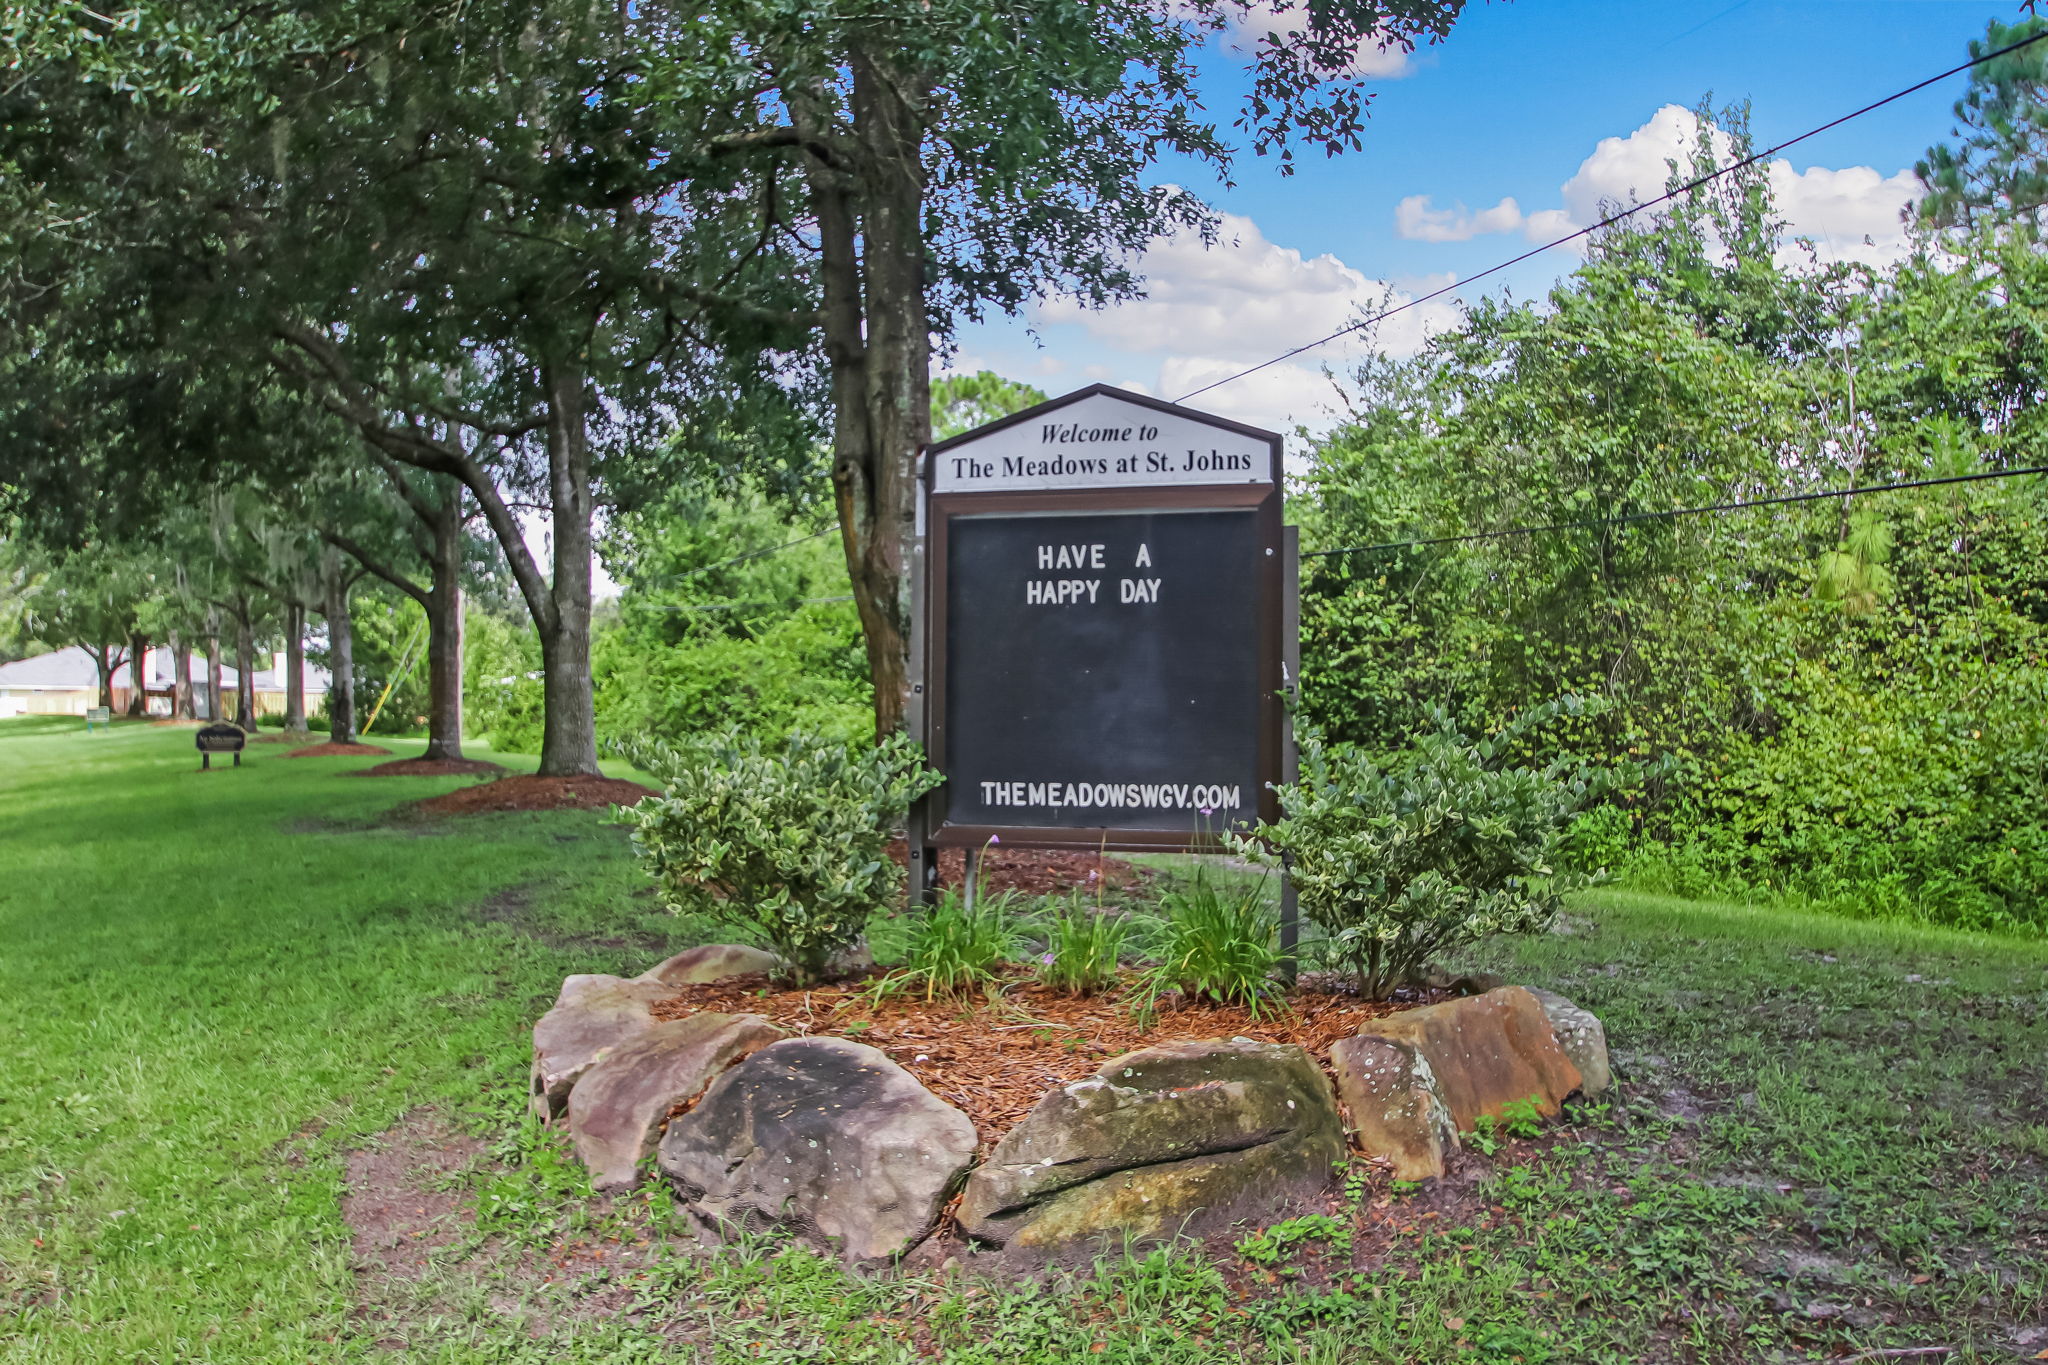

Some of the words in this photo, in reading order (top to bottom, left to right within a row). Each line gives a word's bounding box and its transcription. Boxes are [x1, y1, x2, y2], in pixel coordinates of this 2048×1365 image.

[1041, 424, 1131, 444] Welcome
[1138, 424, 1158, 441] to
[952, 457, 994, 479] The
[1001, 454, 1107, 477] Meadows
[1116, 456, 1137, 474] at
[1146, 451, 1175, 472] St.
[1183, 449, 1252, 472] Johns
[1037, 544, 1106, 570] HAVE
[1135, 543, 1152, 568] A
[1026, 578, 1101, 605] HAPPY
[1120, 578, 1162, 603] DAY
[980, 781, 1240, 809] THEMEADOWSWGV.COM
